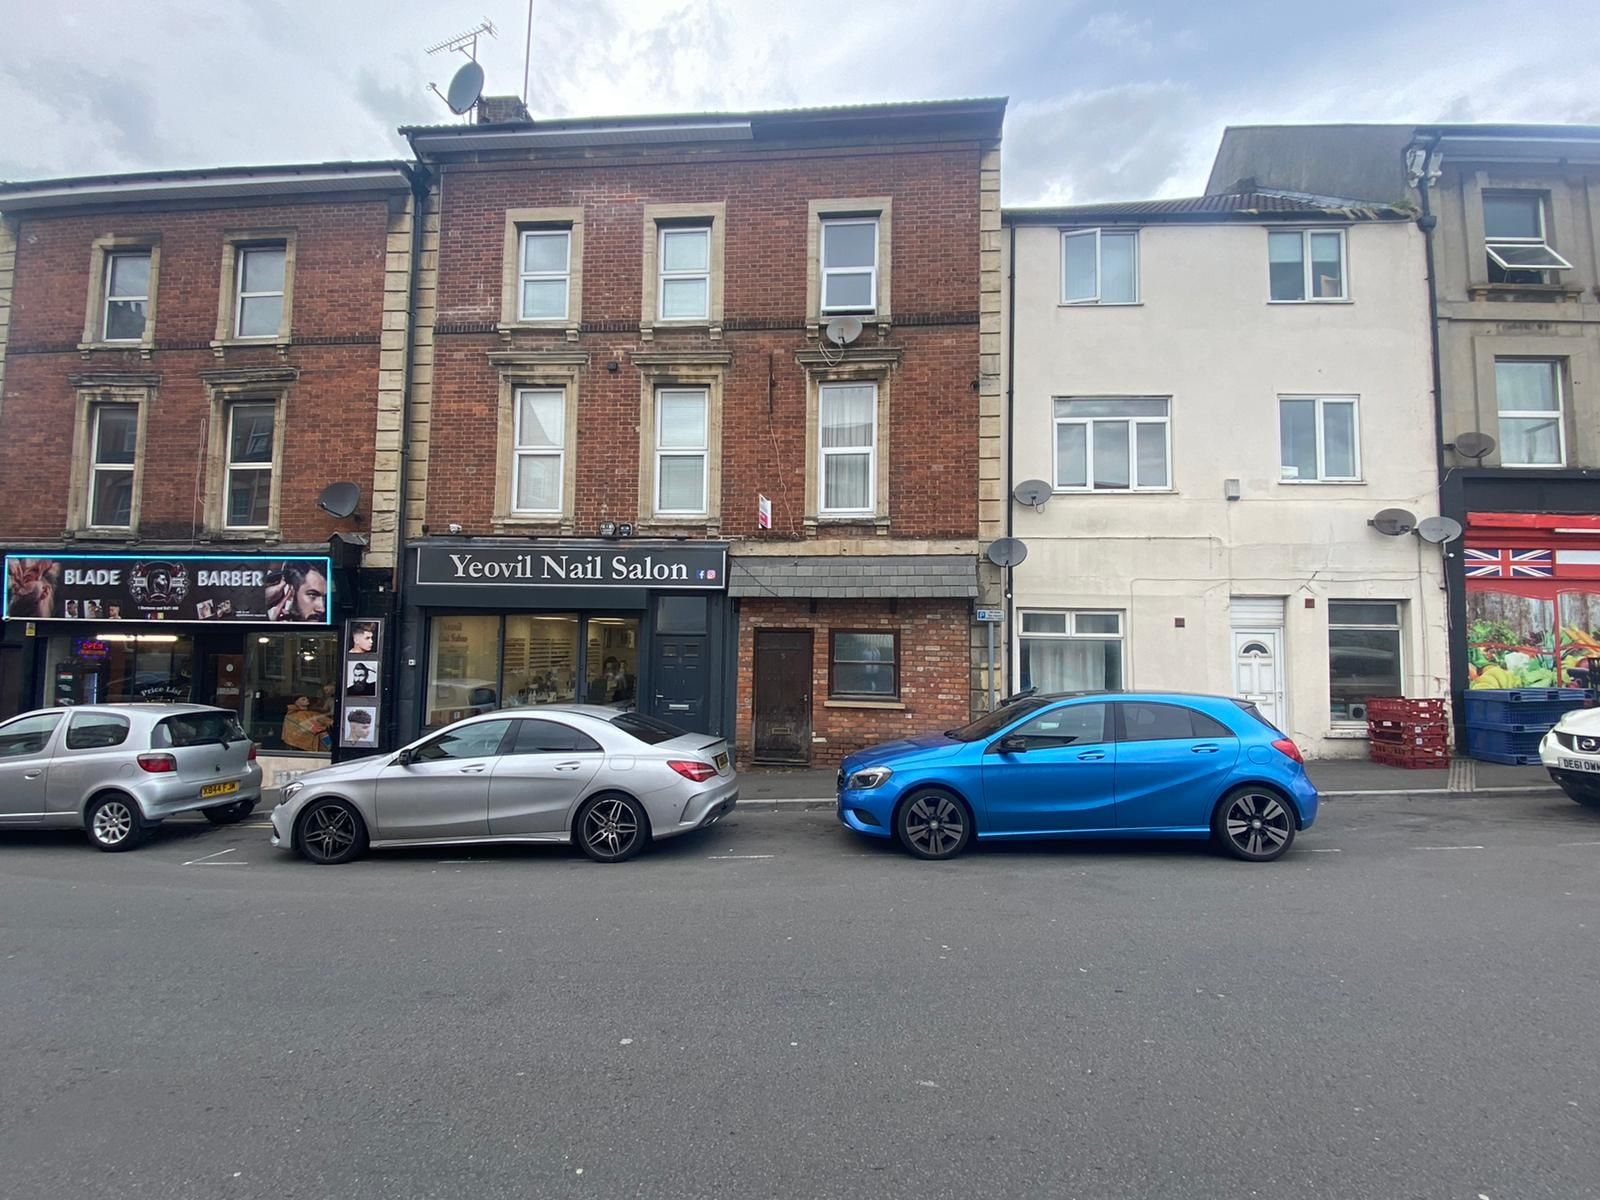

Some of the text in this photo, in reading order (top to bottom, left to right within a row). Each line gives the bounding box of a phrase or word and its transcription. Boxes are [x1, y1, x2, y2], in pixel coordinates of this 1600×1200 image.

[450, 554, 688, 580] Yeovil Nail Salon
[64, 569, 121, 585] BLADE
[197, 570, 264, 586] BARBER
[140, 686, 182, 696] Price List
[1563, 759, 1583, 769] DE61
